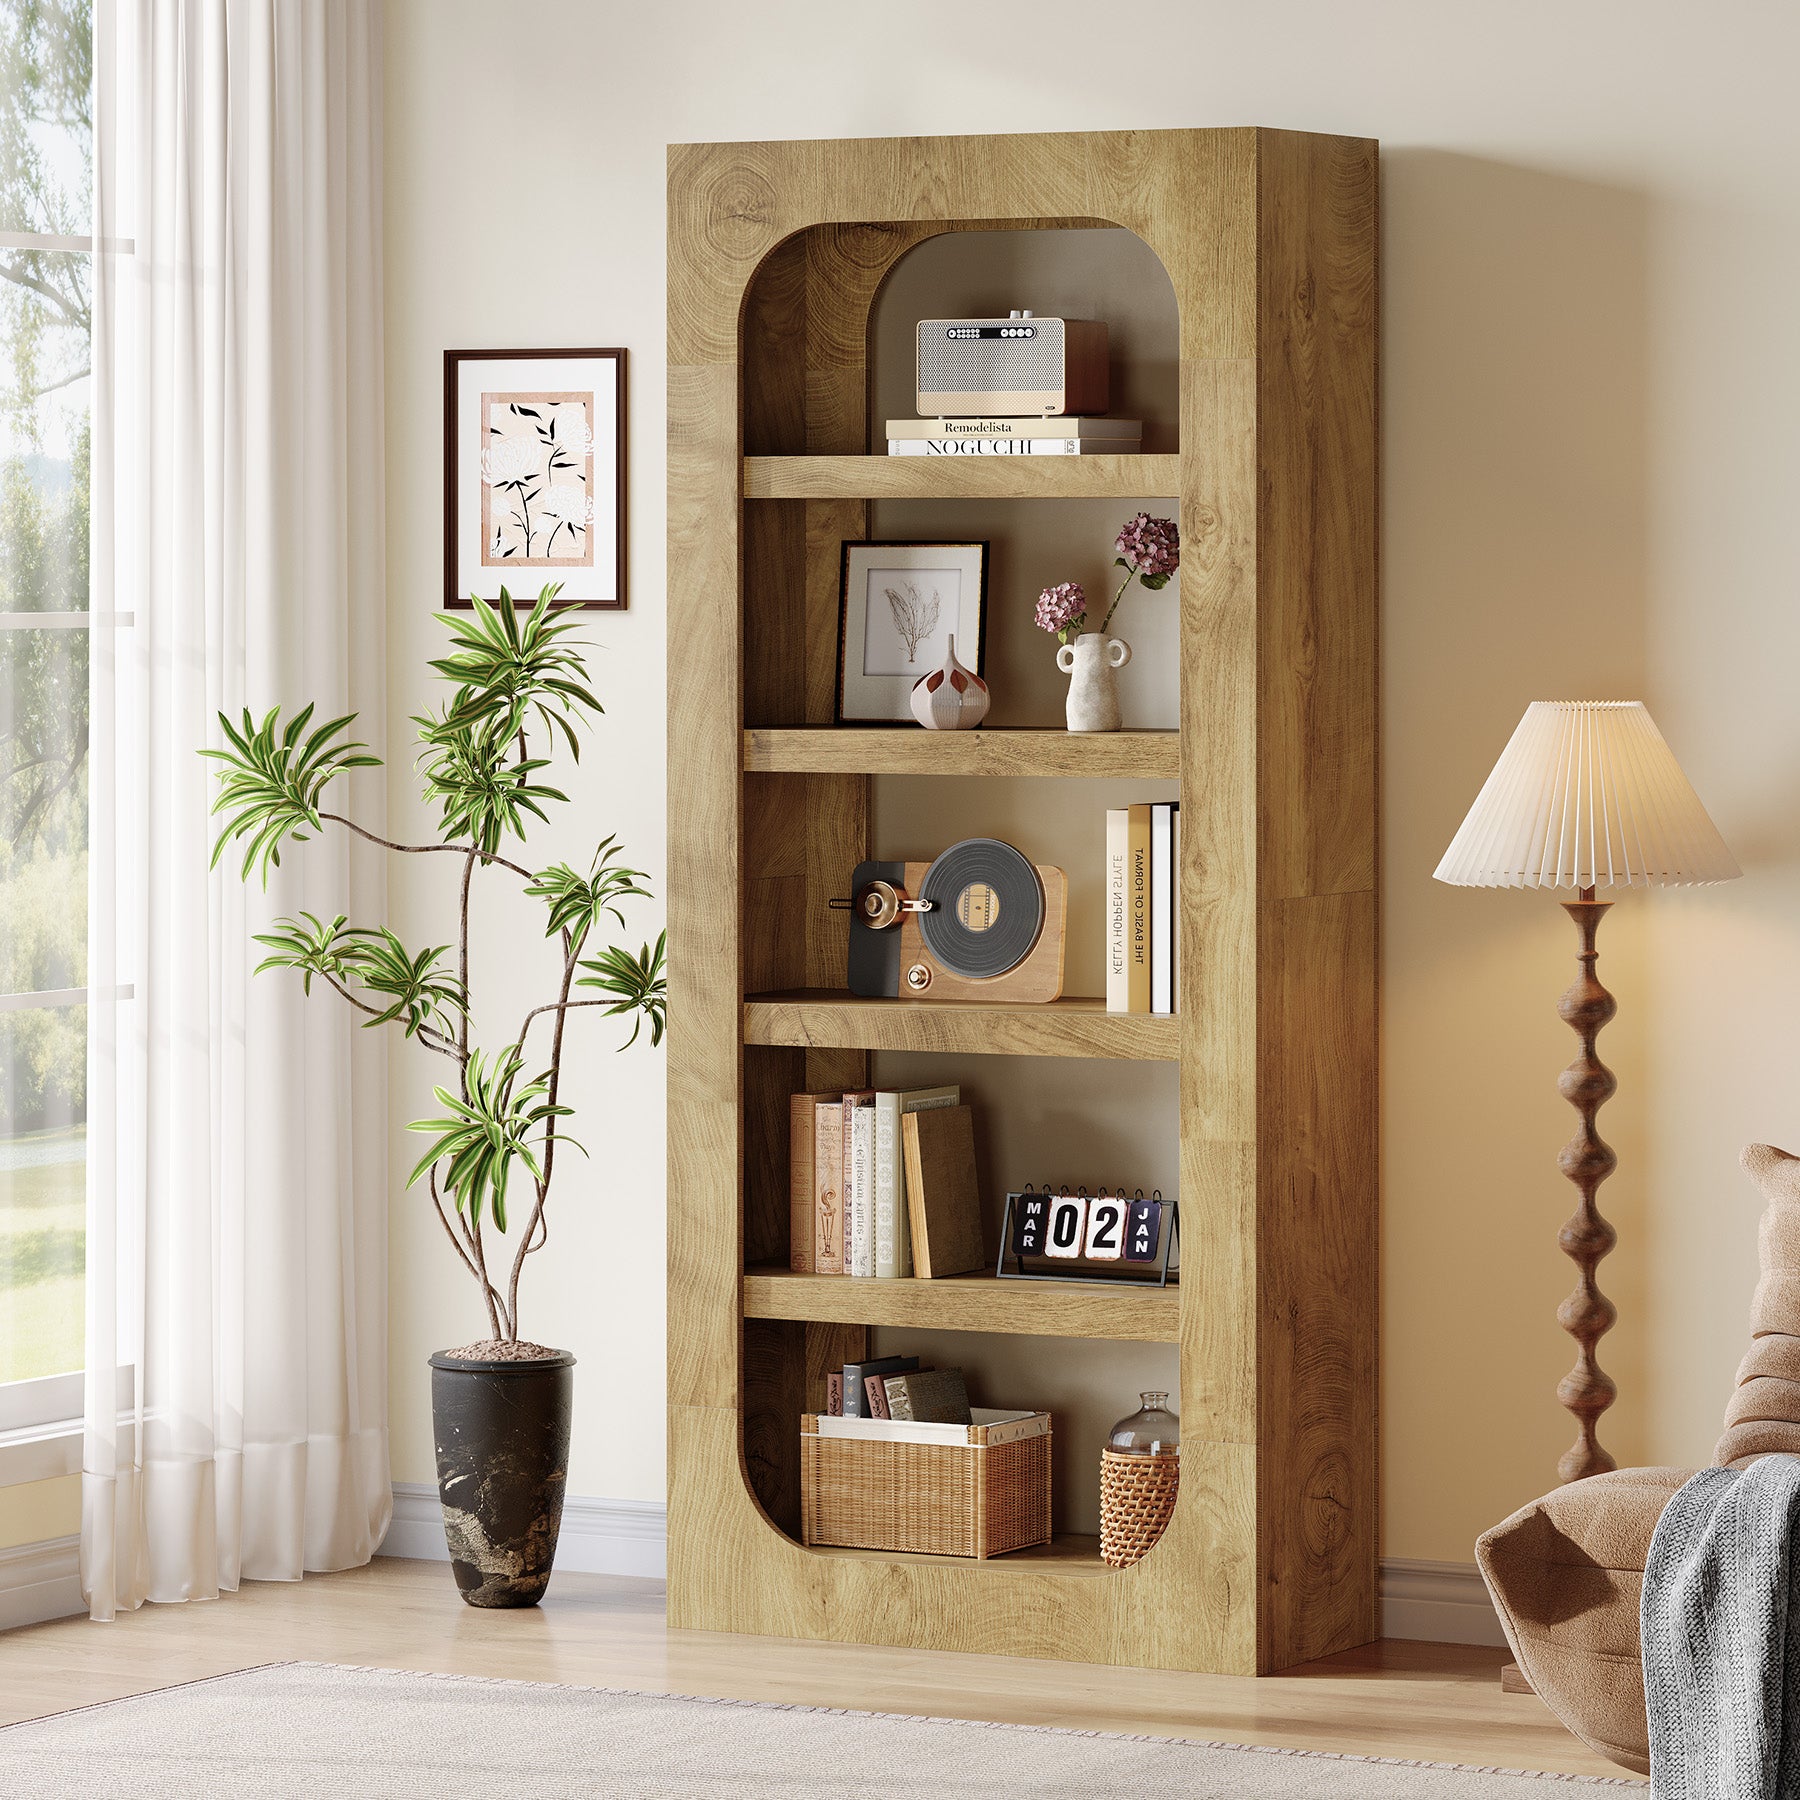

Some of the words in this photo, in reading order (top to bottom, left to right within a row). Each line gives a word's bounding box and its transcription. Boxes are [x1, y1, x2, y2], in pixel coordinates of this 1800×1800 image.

[945, 421, 1012, 432] Remodelista
[926, 439, 1032, 455] NOGUCHI
[1023, 1202, 1042, 1247] MAR
[1135, 1207, 1149, 1253] JAN
